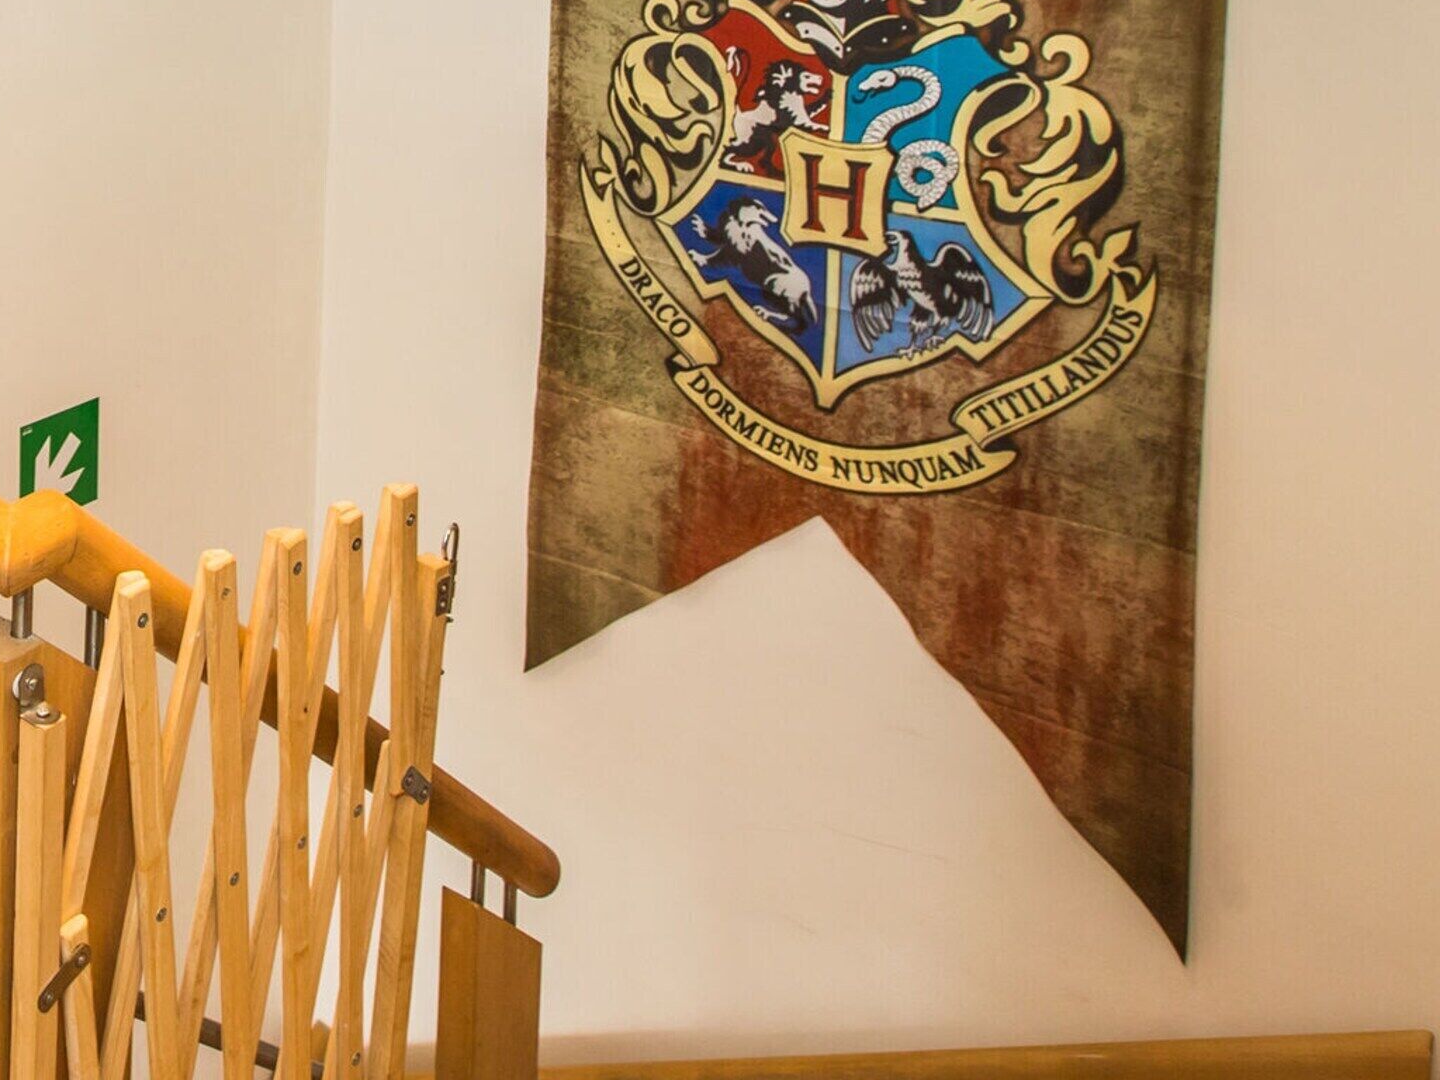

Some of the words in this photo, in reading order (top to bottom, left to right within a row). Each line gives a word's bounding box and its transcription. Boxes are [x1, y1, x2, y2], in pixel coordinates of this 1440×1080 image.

[798, 151, 873, 241] H
[618, 256, 692, 338] DRACO
[687, 371, 820, 473] DORMIENS
[829, 445, 986, 489] NUNQUAM
[968, 304, 1144, 432] TITILLANDUS
